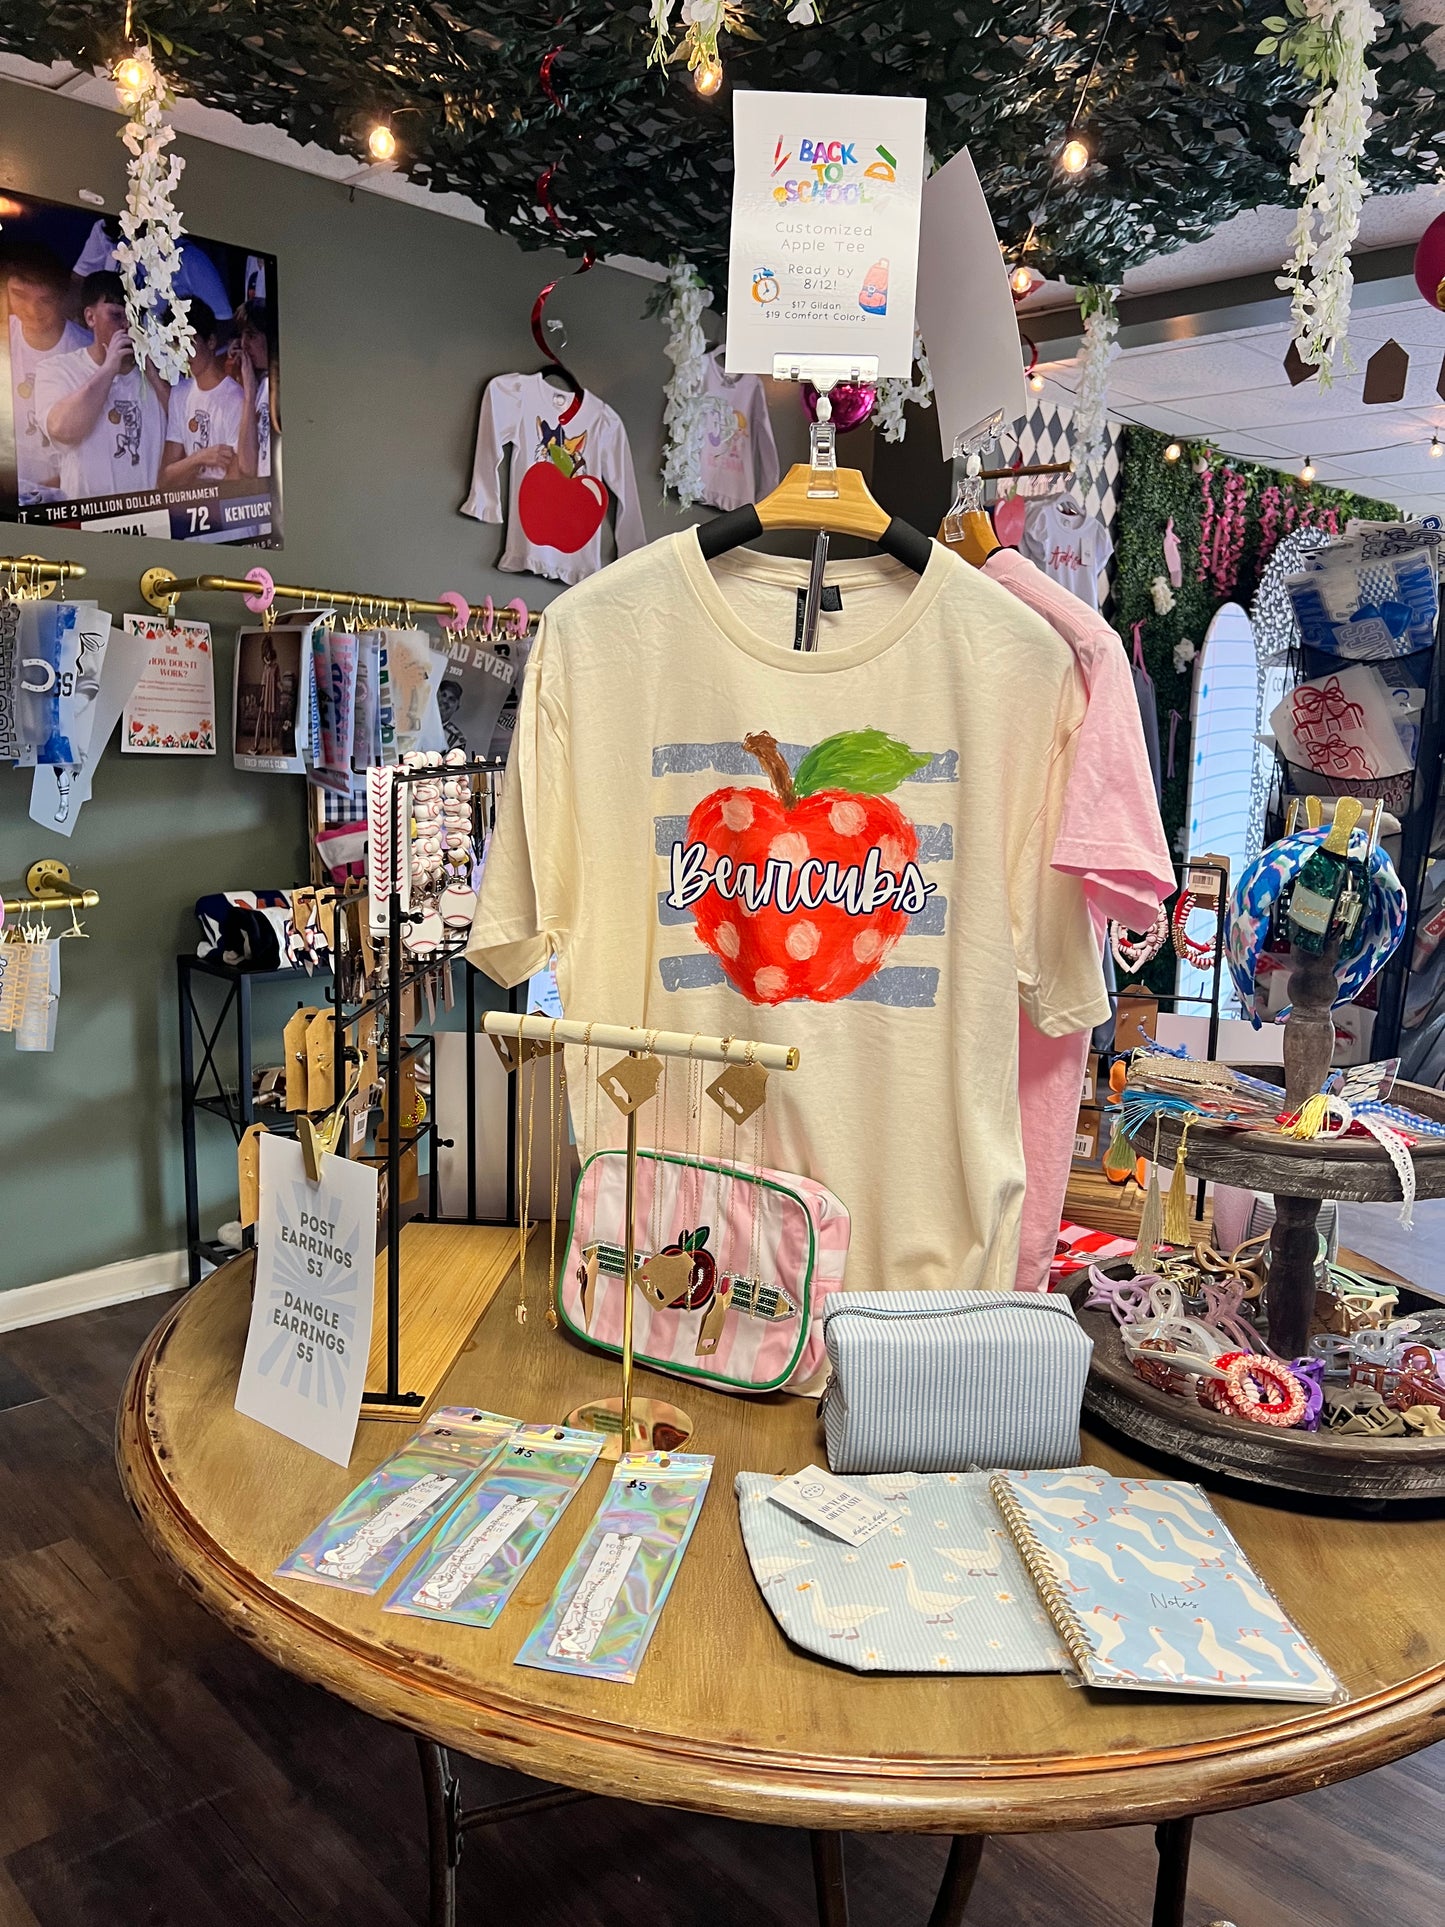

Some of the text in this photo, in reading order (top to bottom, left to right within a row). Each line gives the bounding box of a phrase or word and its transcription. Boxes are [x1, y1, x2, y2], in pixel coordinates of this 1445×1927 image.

[800, 139, 858, 164] BACK
[811, 163, 843, 186] TO
[785, 180, 874, 205] SCHOOL
[776, 222, 872, 236] Customized
[781, 239, 865, 253] Apple Tee
[788, 264, 854, 278] Ready by
[804, 279, 837, 290] 8/12!
[785, 311, 828, 320] Comfort
[834, 312, 866, 322] Colors
[792, 301, 841, 310] $17 Gildan
[46, 506, 68, 520] THE
[71, 505, 78, 518] 2
[80, 499, 123, 516] MILLION
[126, 494, 162, 510] DOLLAR
[163, 486, 220, 504] TOURNAMENT
[186, 506, 210, 532] 72
[160, 669, 188, 678] WORK?
[472, 649, 514, 684] EVER
[667, 841, 937, 915] Bearcubs
[300, 1212, 336, 1240] POST
[282, 1226, 352, 1269] EARRINGS
[284, 1291, 340, 1330] DANGLE
[274, 1309, 345, 1356] EARRINGS
[514, 1446, 535, 1458] $5
[626, 1480, 647, 1490] $5
[1150, 1592, 1200, 1609] Notes
